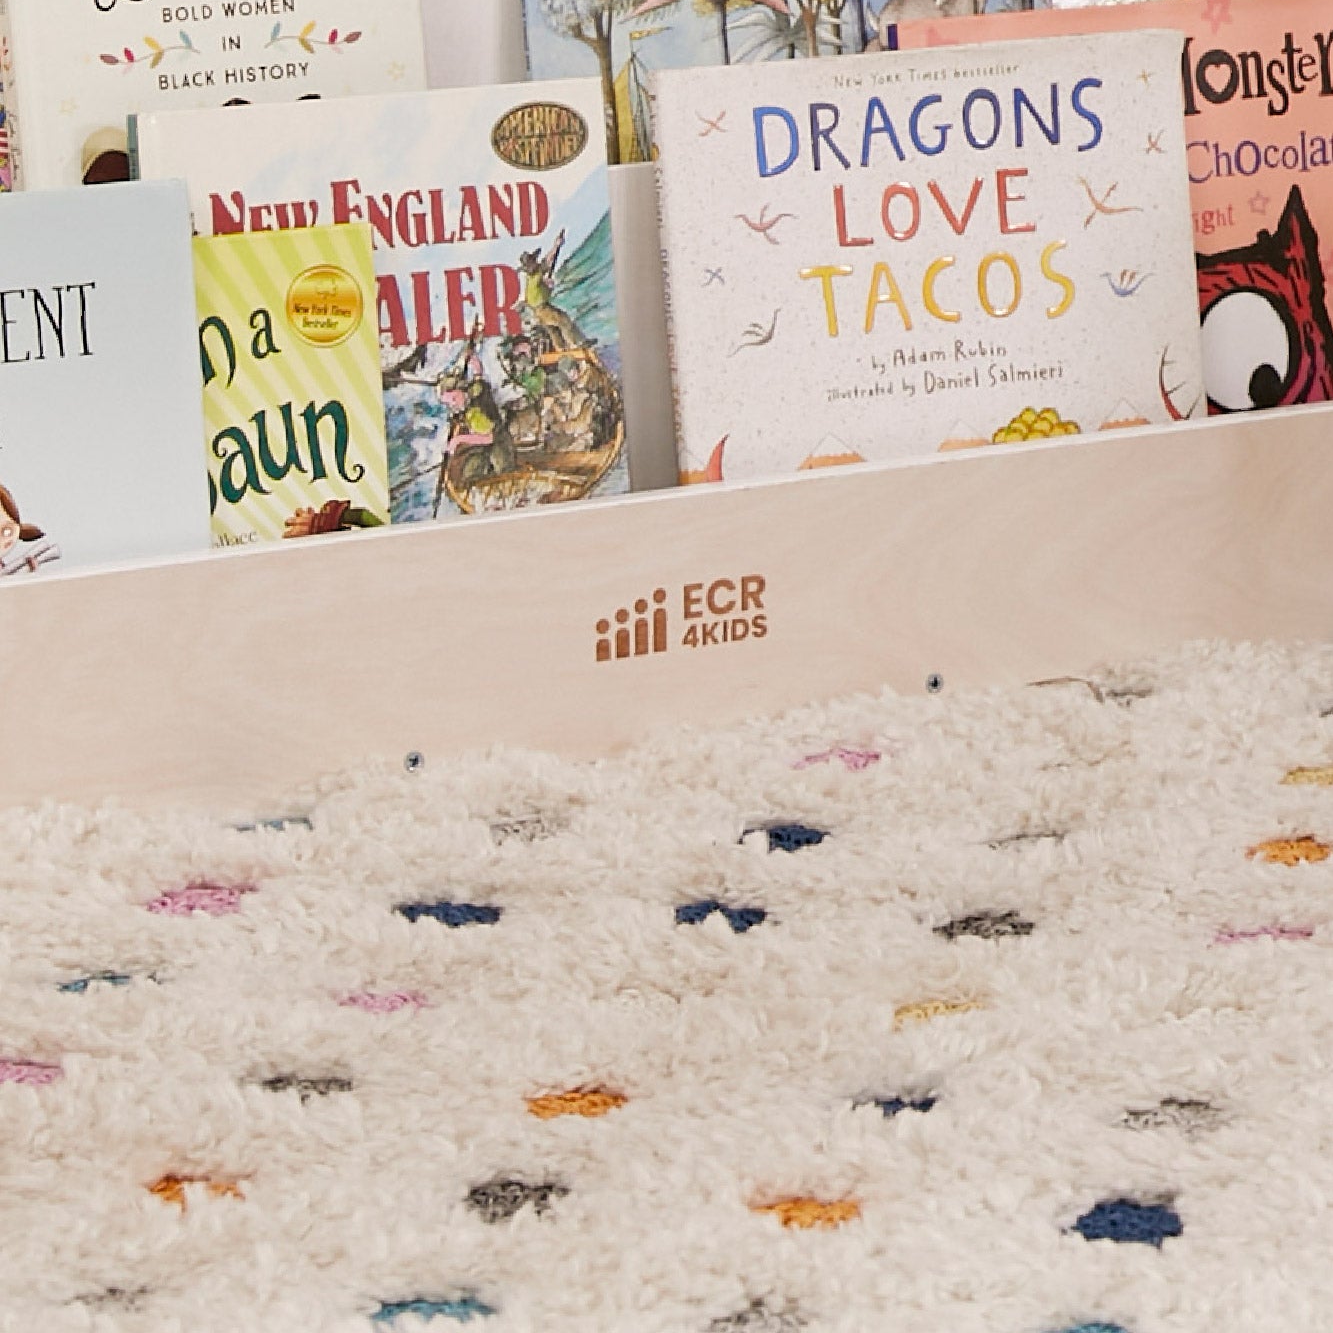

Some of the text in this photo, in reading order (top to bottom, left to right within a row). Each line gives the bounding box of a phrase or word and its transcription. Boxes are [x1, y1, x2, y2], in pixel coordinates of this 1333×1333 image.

[162, 5, 213, 23] BOLD
[221, 36, 241, 52] IN
[158, 62, 309, 90] BLACK HISTORY
[752, 77, 1103, 178] DRAGONS
[330, 179, 549, 249] ENGLAND
[832, 167, 1036, 247] LOVE
[799, 239, 1076, 337] TACOS
[249, 307, 281, 360] a
[893, 348, 947, 368] Adam
[954, 339, 1007, 361] Rubin
[923, 366, 979, 395] Daniel
[988, 360, 1064, 386] Salmieri
[683, 573, 767, 621] ECR
[681, 613, 768, 649] 4KIDS
